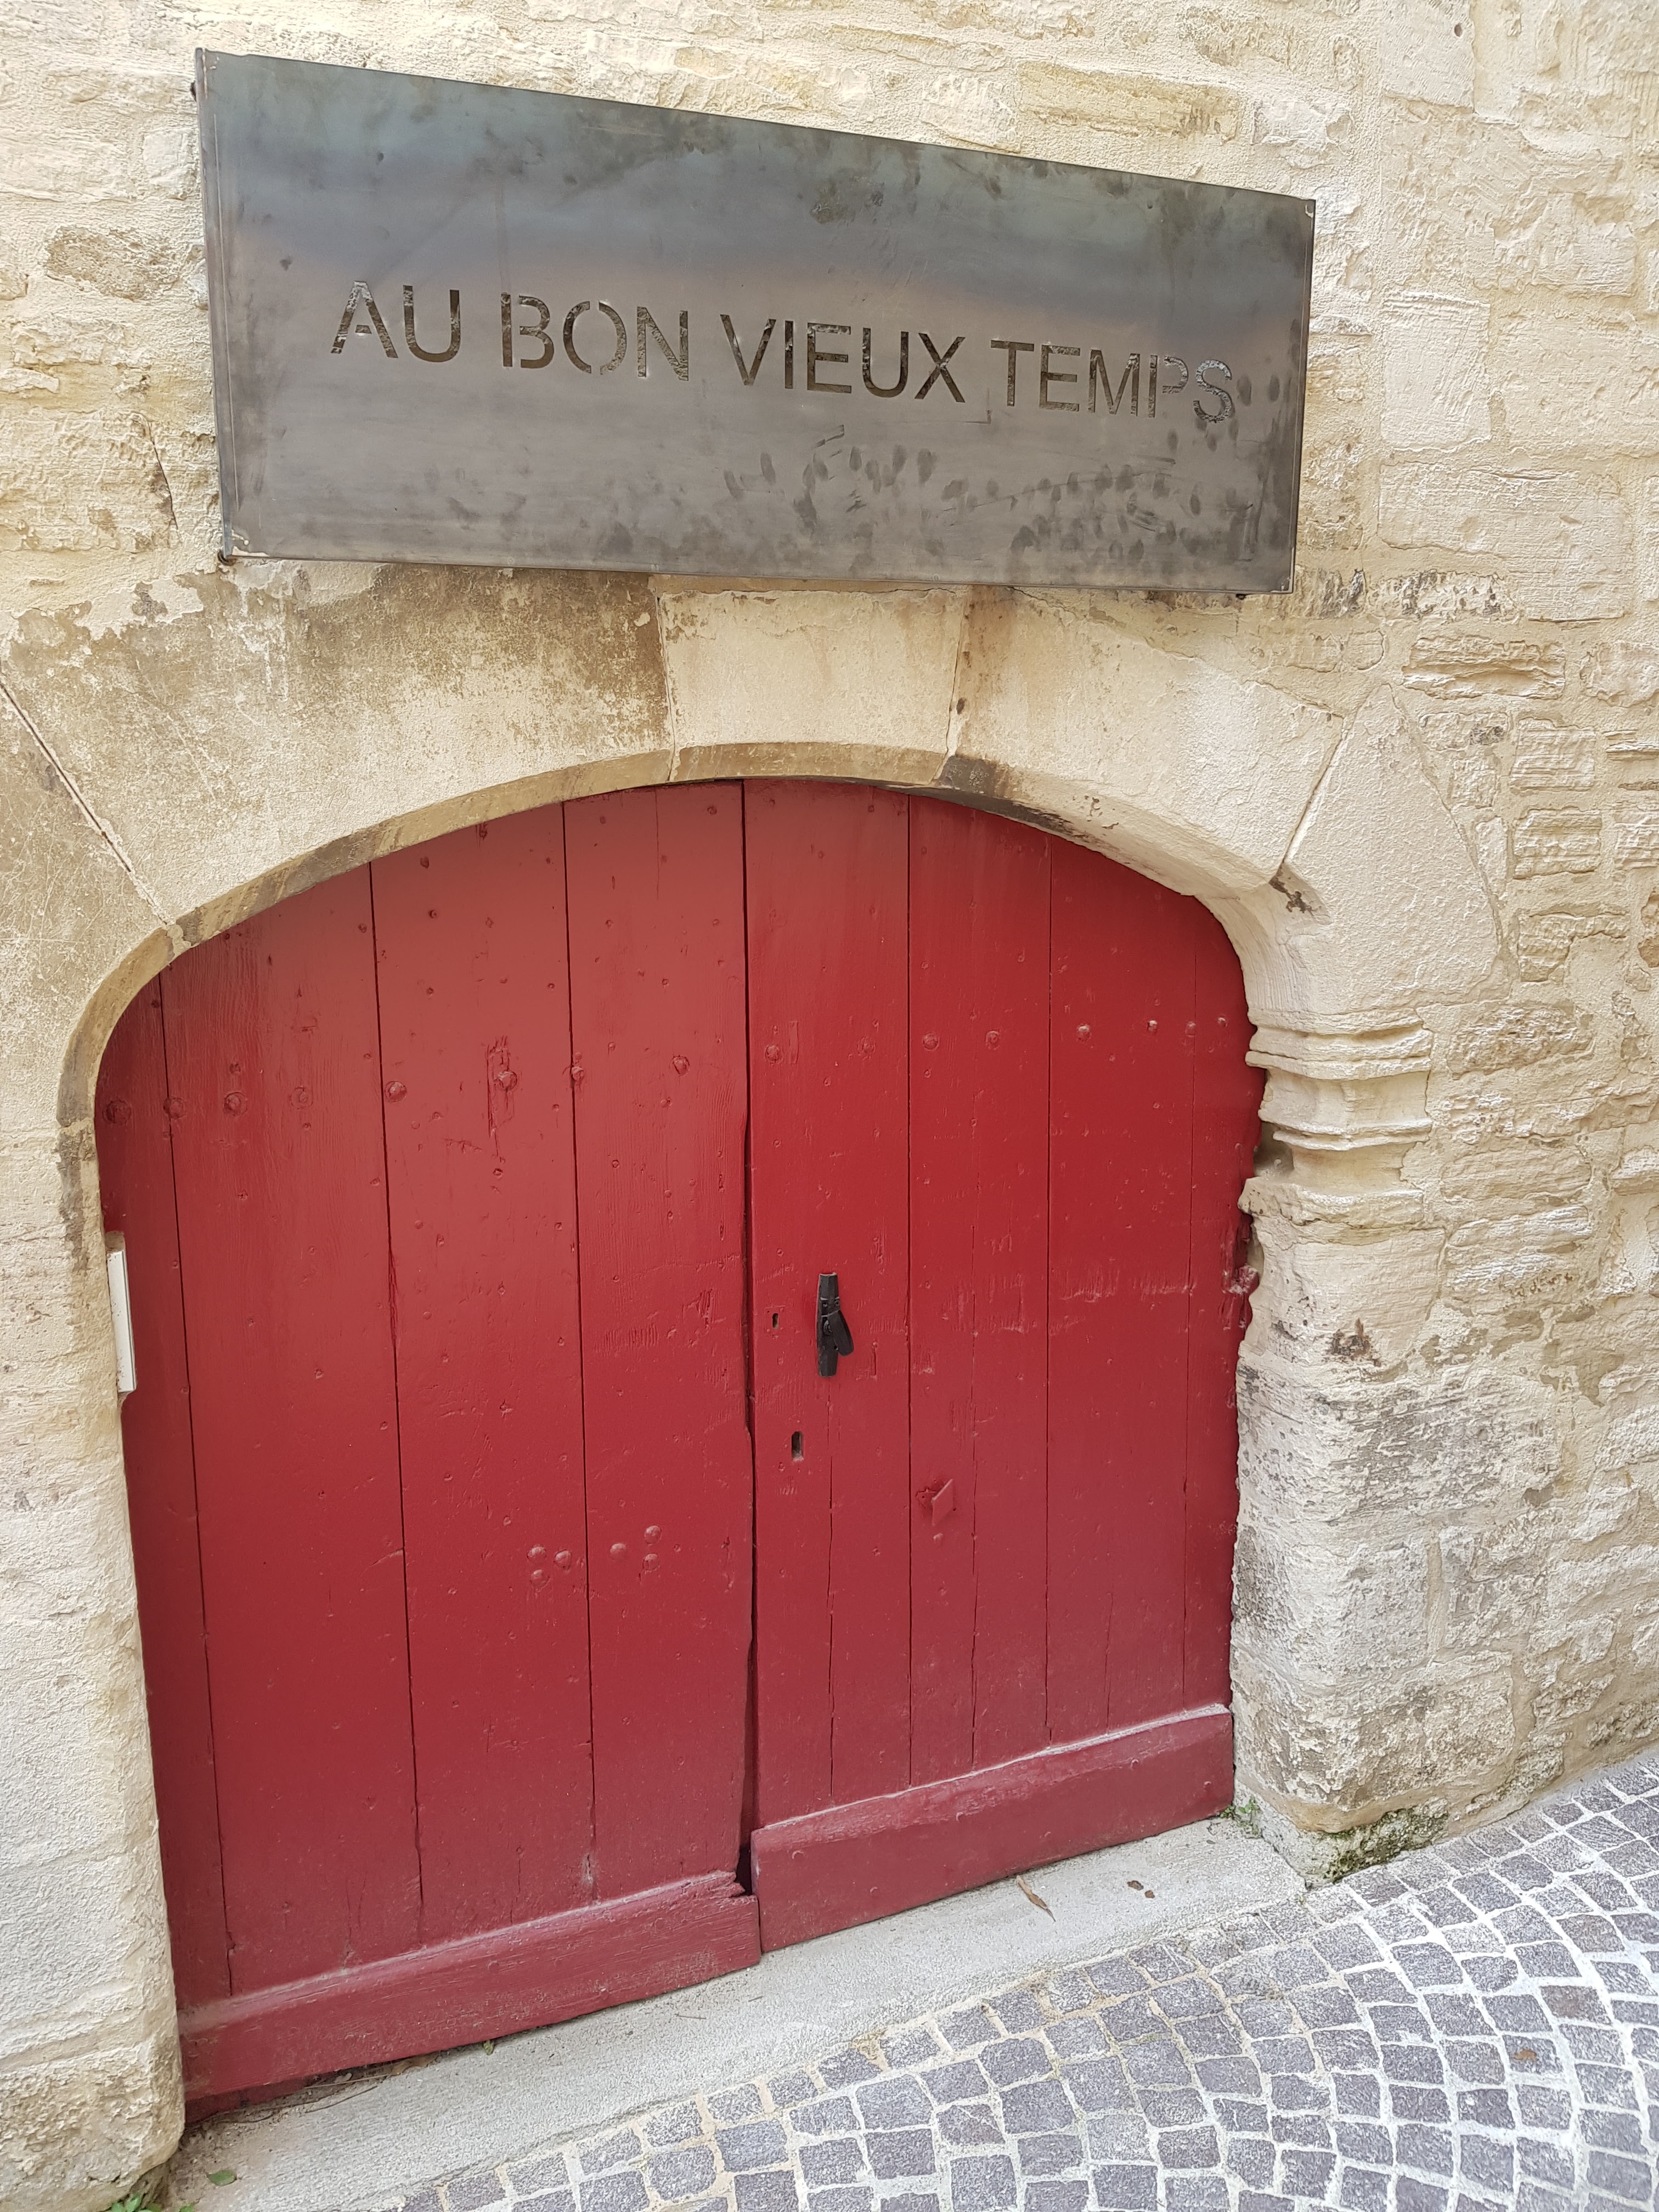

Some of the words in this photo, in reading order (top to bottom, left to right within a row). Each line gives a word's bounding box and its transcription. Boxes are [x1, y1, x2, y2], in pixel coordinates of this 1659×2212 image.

[330, 280, 461, 363] AU
[500, 292, 689, 381] BON
[720, 314, 966, 403] VIEUX
[990, 339, 1232, 424] TEMPS
